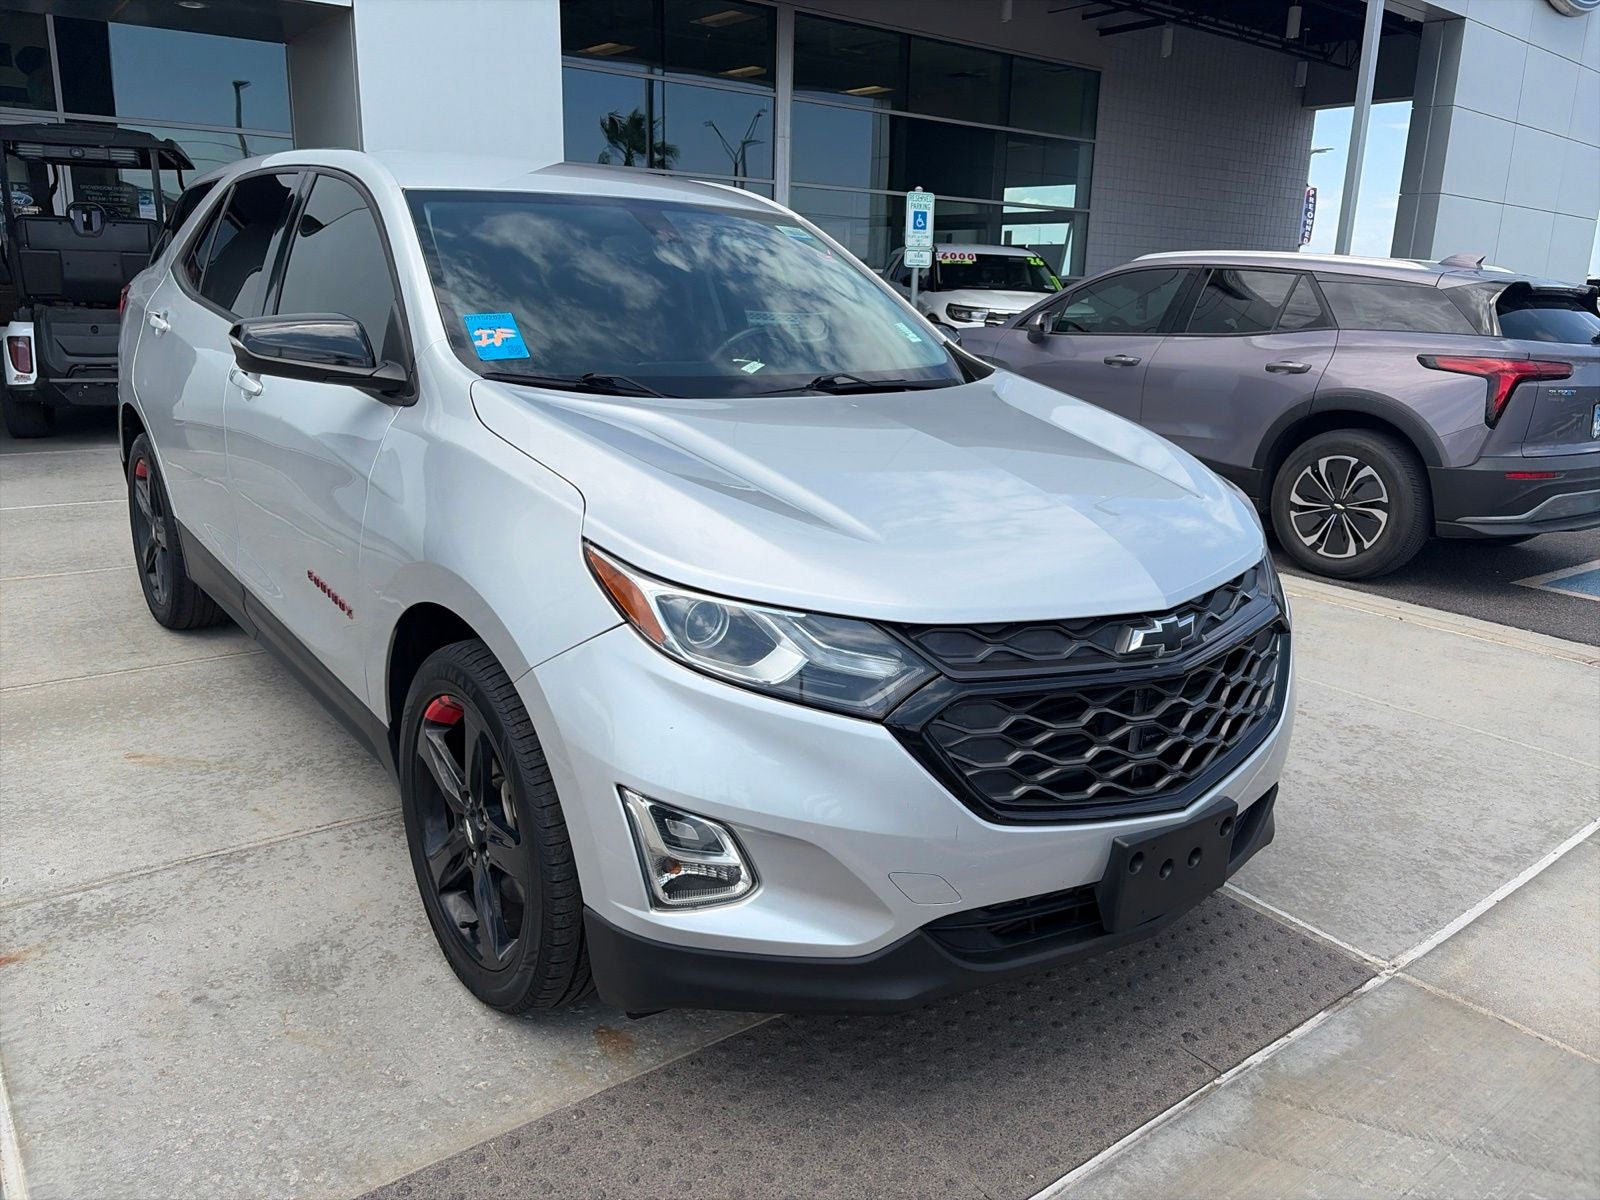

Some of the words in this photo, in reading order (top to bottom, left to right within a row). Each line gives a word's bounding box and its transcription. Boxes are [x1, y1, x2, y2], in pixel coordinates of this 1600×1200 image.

[909, 193, 932, 203] RESERVED
[910, 202, 931, 210] PARKING
[306, 569, 354, 620] EQUINOX
